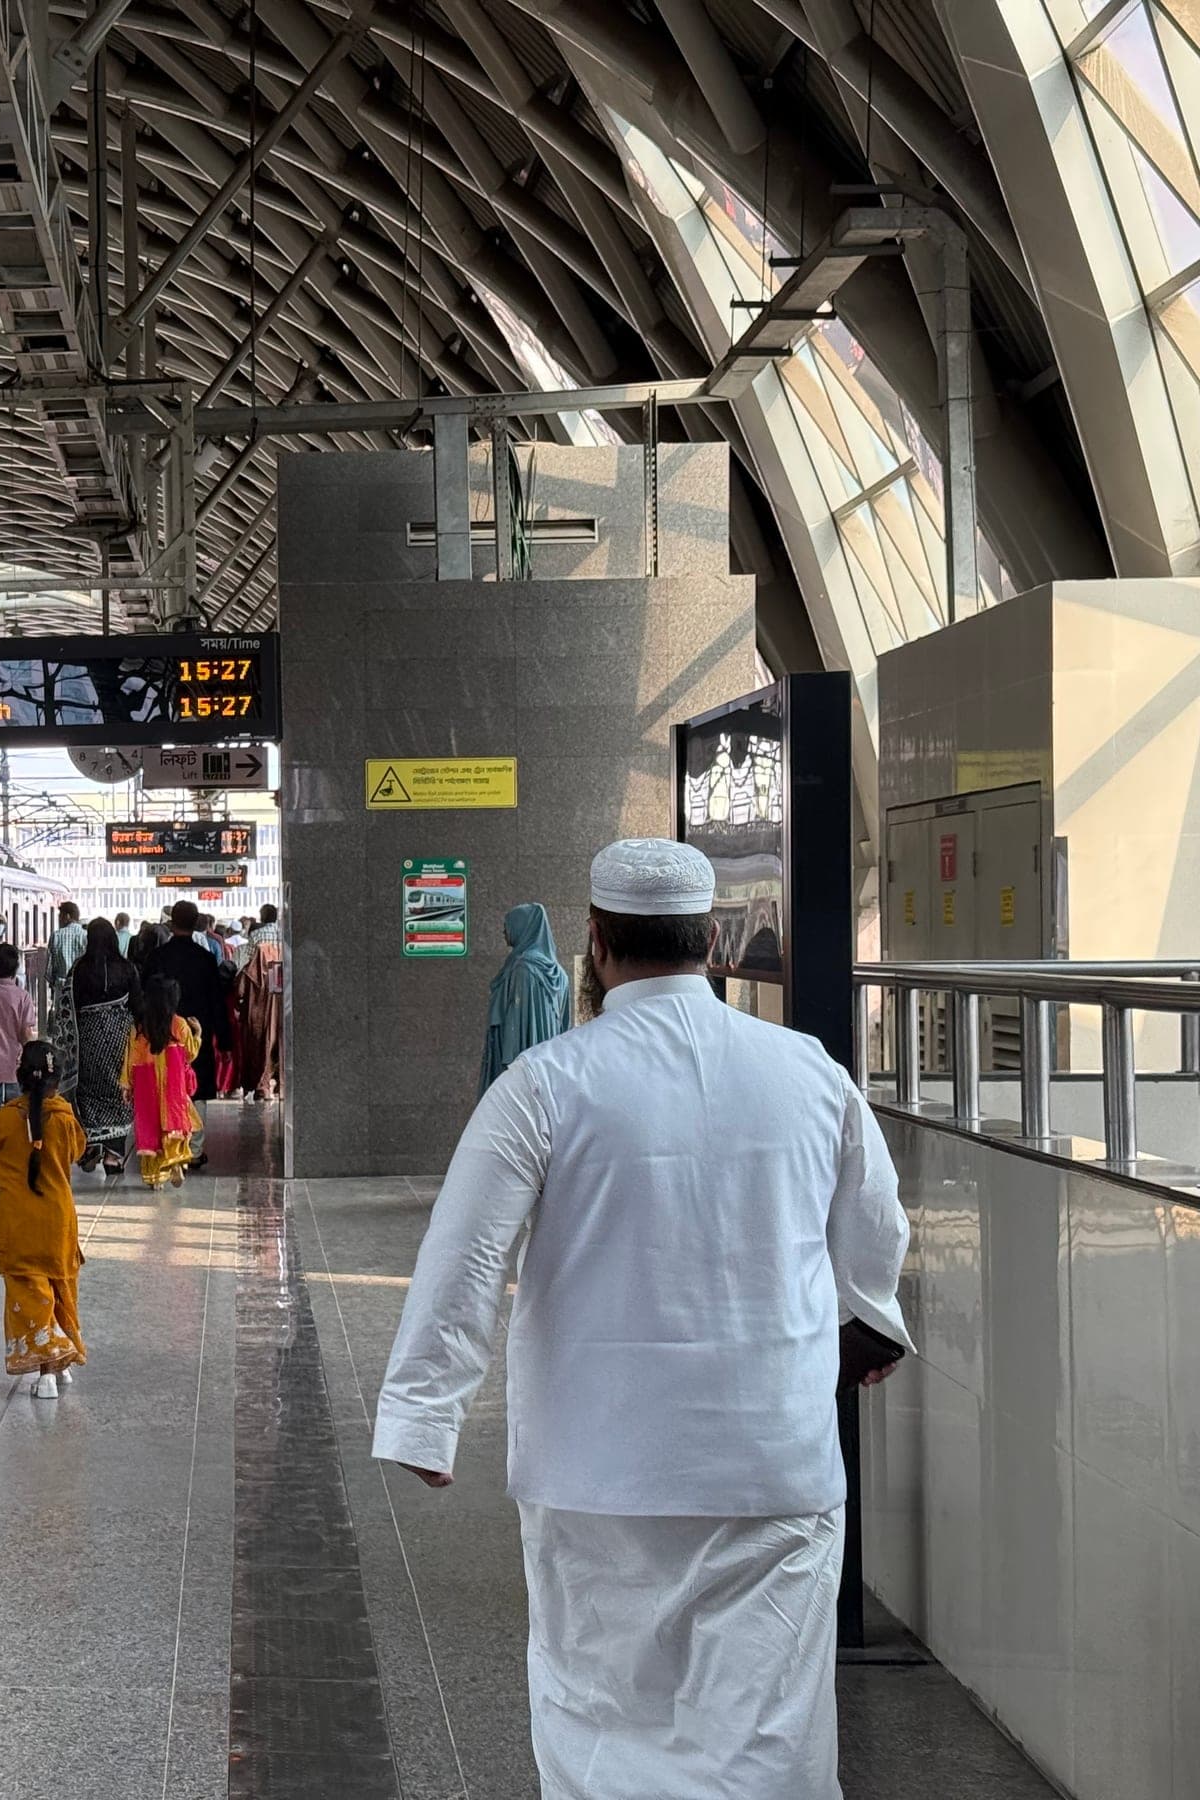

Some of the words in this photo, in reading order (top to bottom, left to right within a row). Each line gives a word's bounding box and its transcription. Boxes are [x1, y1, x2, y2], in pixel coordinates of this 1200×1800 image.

[180, 660, 251, 681] 15:27
[180, 696, 252, 717] 15:27
[182, 771, 197, 780] Lift
